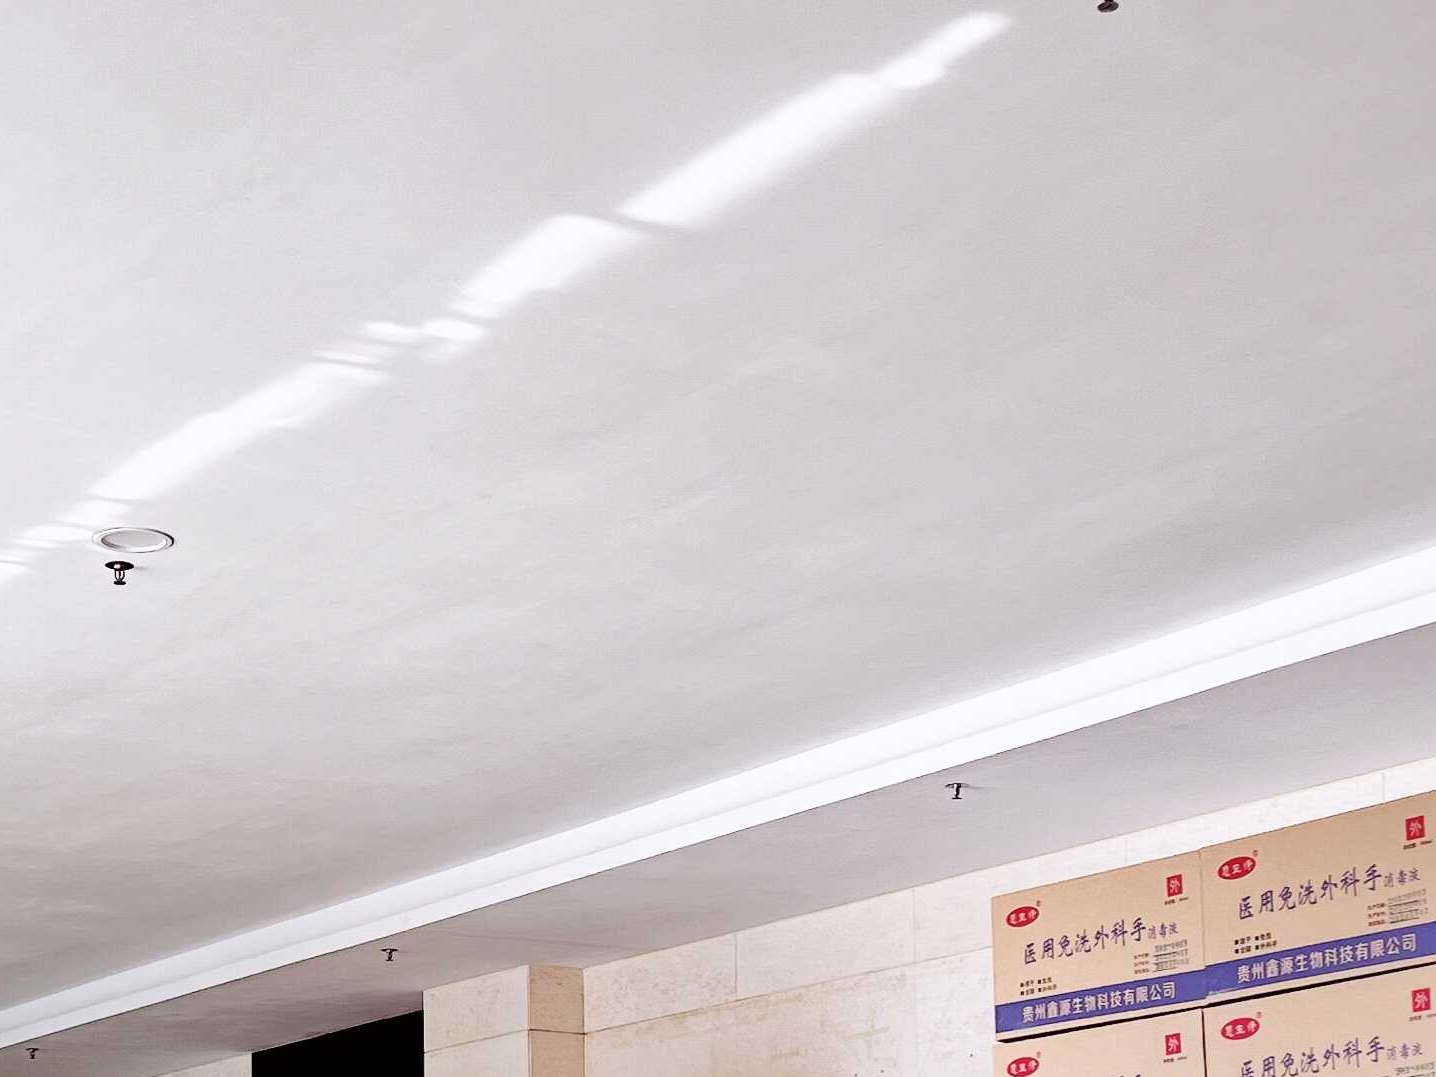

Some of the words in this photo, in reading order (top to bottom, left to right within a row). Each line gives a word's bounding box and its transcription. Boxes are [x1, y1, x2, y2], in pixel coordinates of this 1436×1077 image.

[1239, 864, 1421, 920] 医用免洗外科手消毒液
[1024, 917, 1179, 965] 医用免洗外科手消毒液
[1237, 932, 1417, 983] 贵州鑫源生物科技有限公司
[1022, 981, 1177, 1023] 贵州鑫源生物科技有限公司
